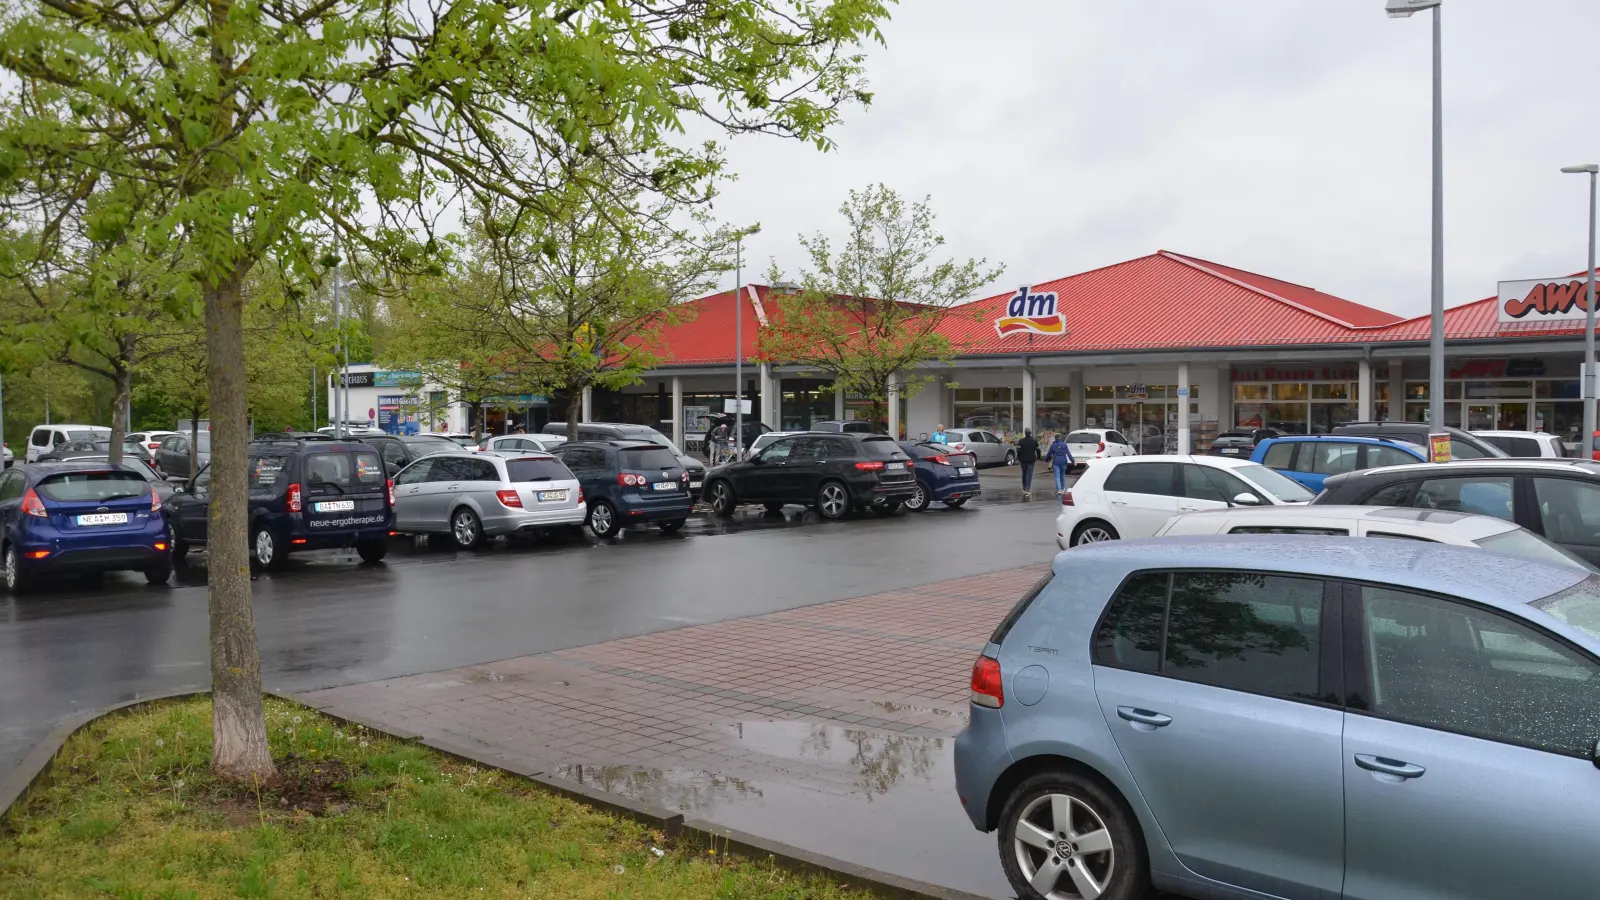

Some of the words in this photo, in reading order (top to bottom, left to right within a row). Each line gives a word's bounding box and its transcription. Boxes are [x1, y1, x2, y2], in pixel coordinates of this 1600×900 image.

[1009, 286, 1055, 317] dm
[112, 514, 126, 522] 359
[310, 514, 385, 527] neue-ergotherapie.de
[1027, 645, 1059, 655] TEAM
